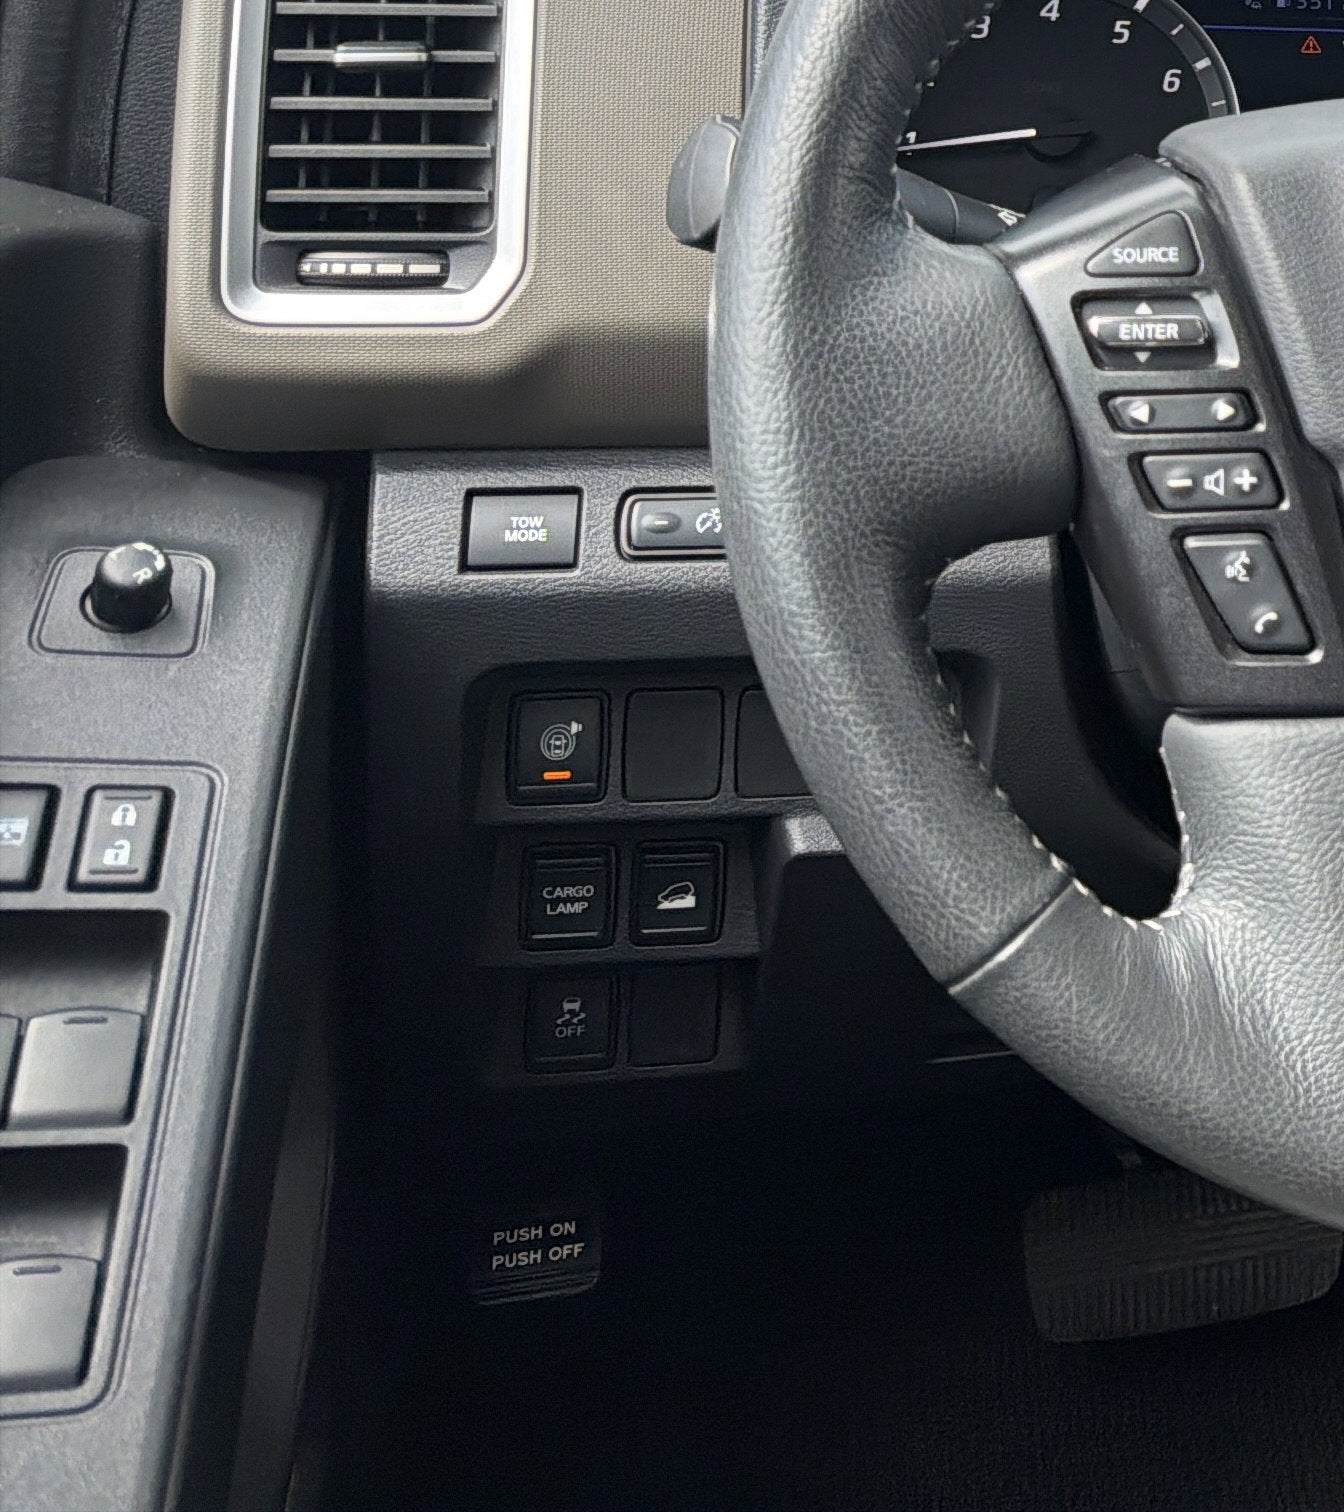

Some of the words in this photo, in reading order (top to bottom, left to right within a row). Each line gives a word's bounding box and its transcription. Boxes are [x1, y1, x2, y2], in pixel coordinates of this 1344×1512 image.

[970, 15, 991, 39] 3
[1111, 20, 1132, 44] 5
[1162, 69, 1182, 94] 6
[1112, 246, 1180, 264] SOURCE
[1118, 323, 1180, 341] ENTER
[510, 515, 545, 529] TOW
[504, 526, 548, 543] MODE
[132, 567, 153, 585] R
[542, 884, 595, 900] CARGO
[545, 900, 589, 916] LAMP
[554, 1023, 586, 1039] OFF
[492, 1225, 544, 1246] PUSH
[549, 1220, 576, 1237] ON
[491, 1249, 543, 1271] PUSH
[548, 1242, 585, 1261] OFF
